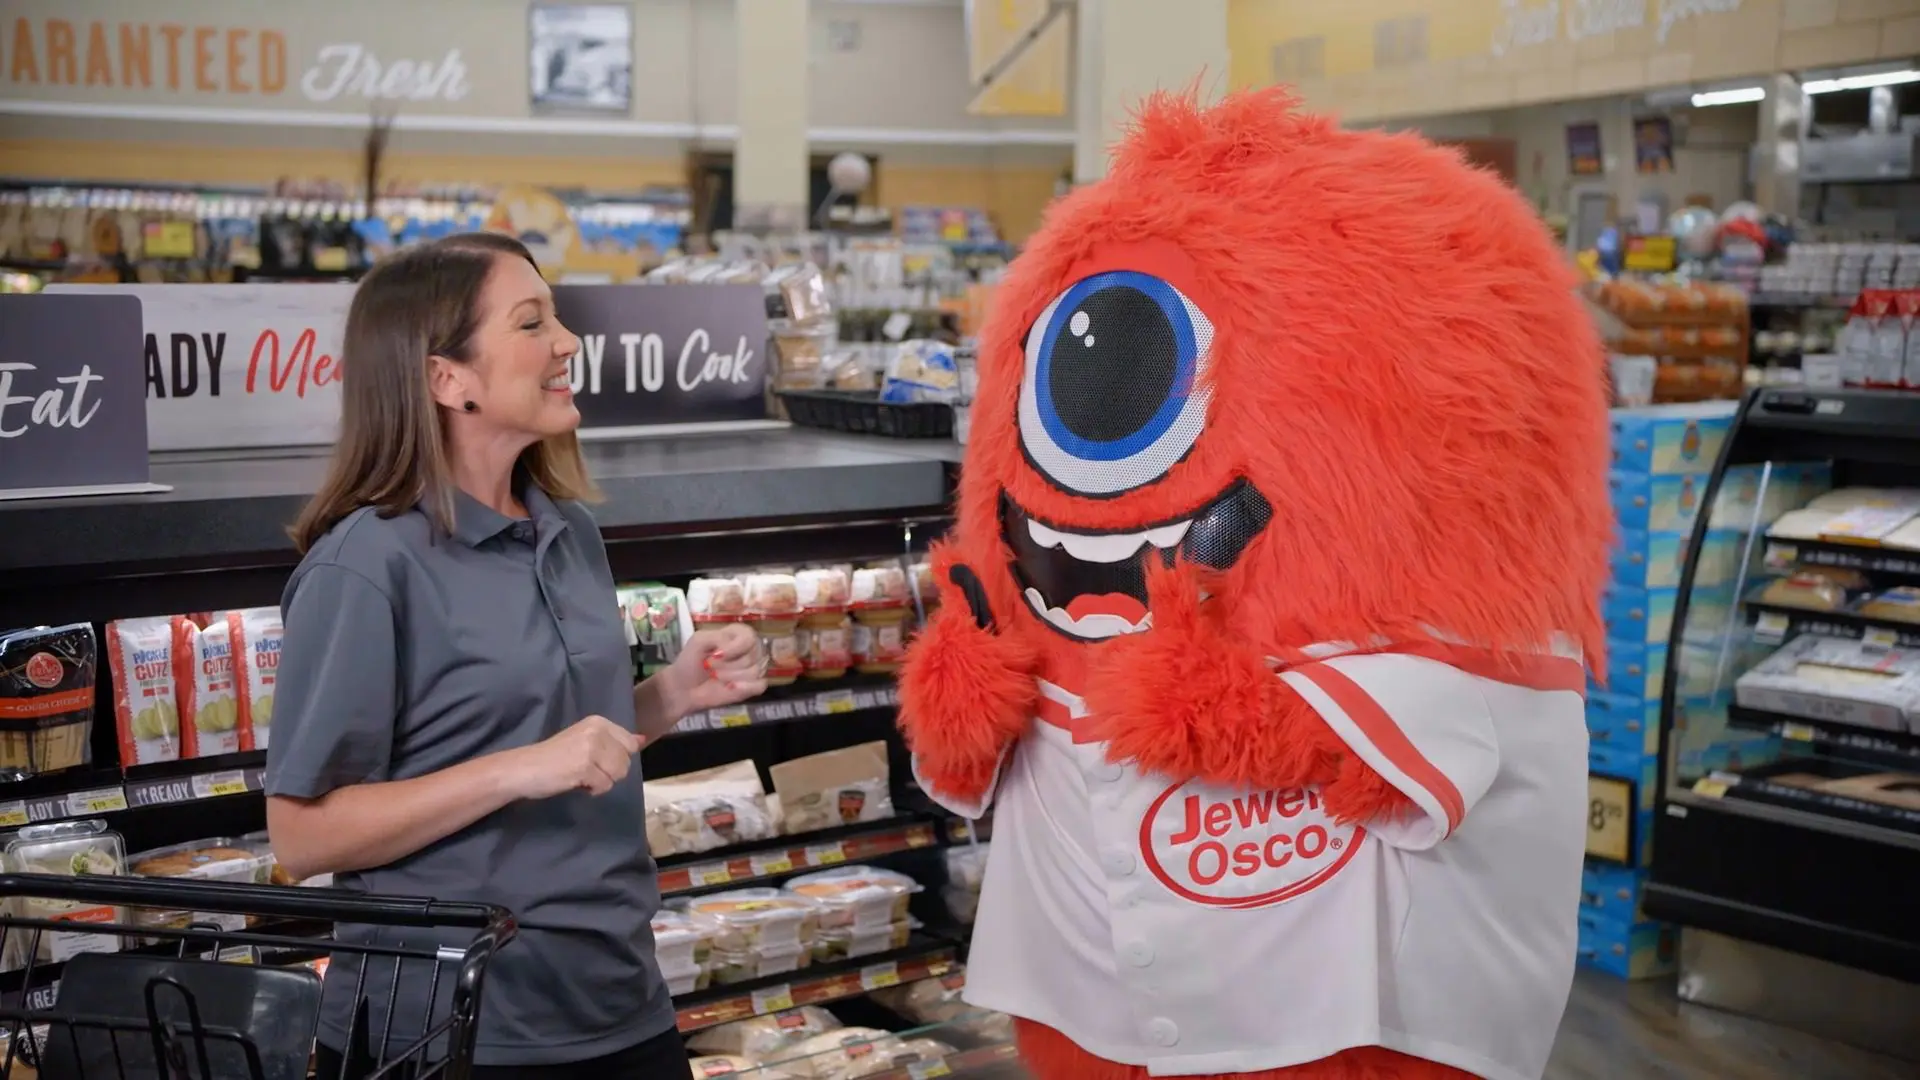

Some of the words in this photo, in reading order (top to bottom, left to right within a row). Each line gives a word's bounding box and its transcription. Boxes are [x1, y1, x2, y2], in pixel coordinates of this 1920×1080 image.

[0, 17, 287, 95] ARANTEED
[302, 42, 471, 100] Fresh
[145, 332, 226, 399] ADY
[620, 333, 664, 393] TO
[676, 328, 754, 392] Cook
[0, 362, 104, 438] Eat
[132, 648, 168, 664] PICKLE
[134, 661, 169, 681] CUTZ
[29, 801, 54, 822] ADY
[149, 782, 190, 805] READY
